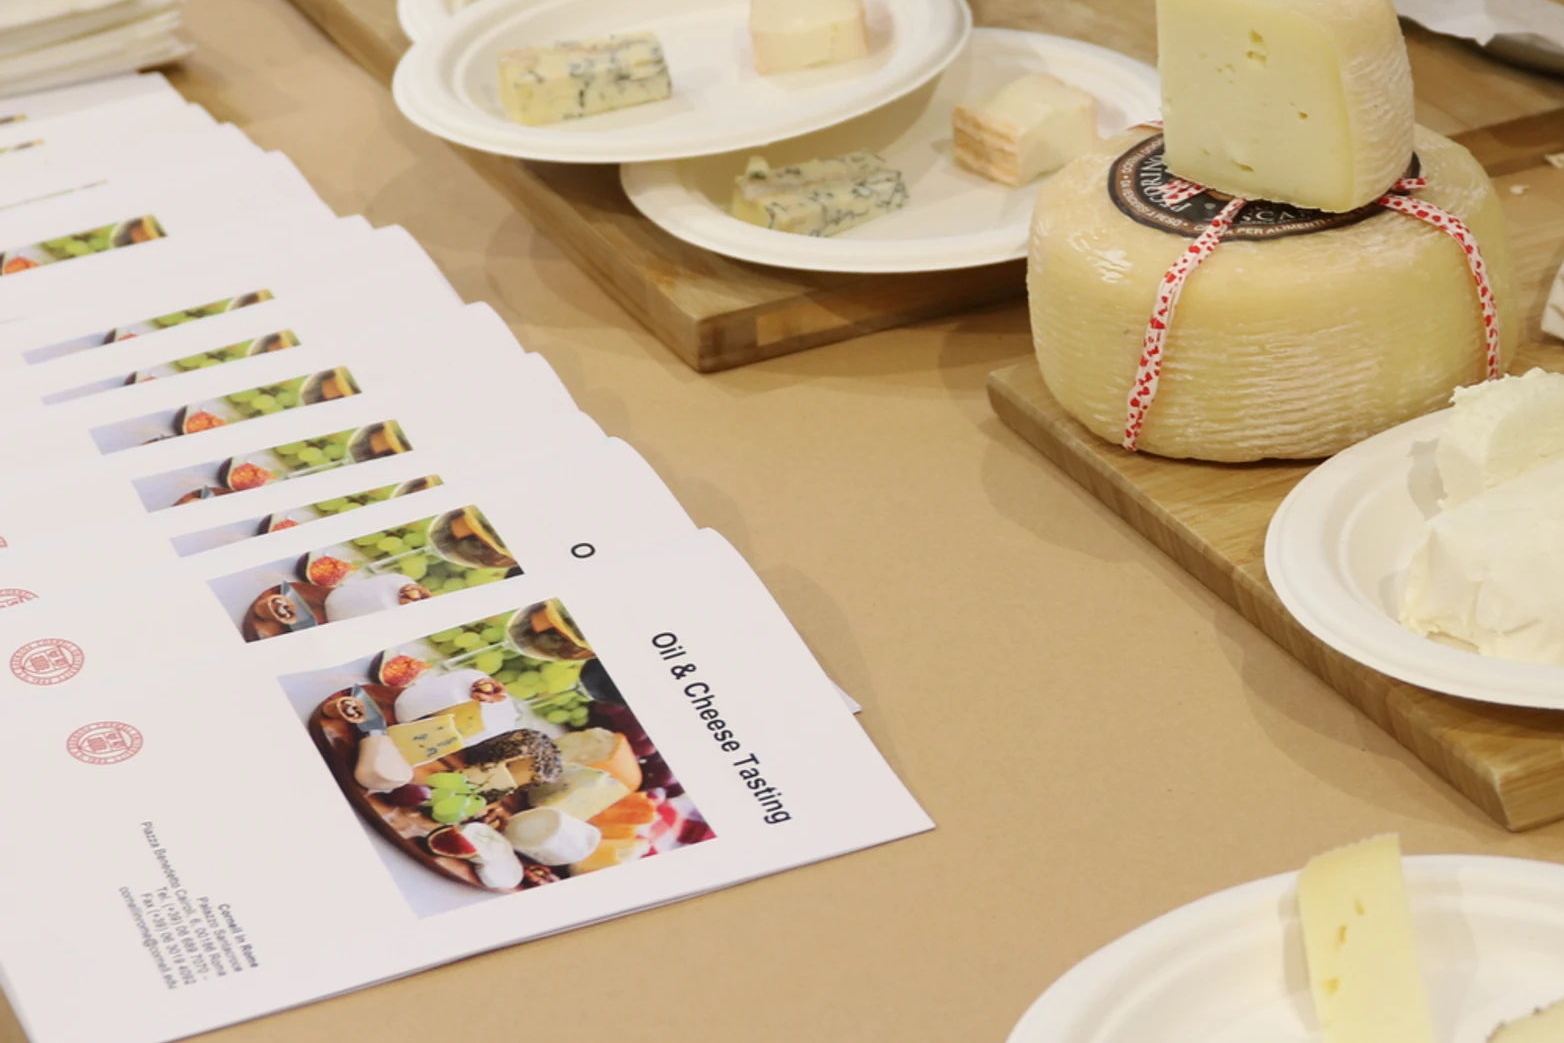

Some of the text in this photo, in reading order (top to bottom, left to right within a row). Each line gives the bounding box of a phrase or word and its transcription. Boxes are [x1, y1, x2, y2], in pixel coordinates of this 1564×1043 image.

[1140, 155, 1192, 212] PCORIN
[652, 632, 793, 825] Oil & Cheese Tasting
[140, 821, 160, 849] Piazza
